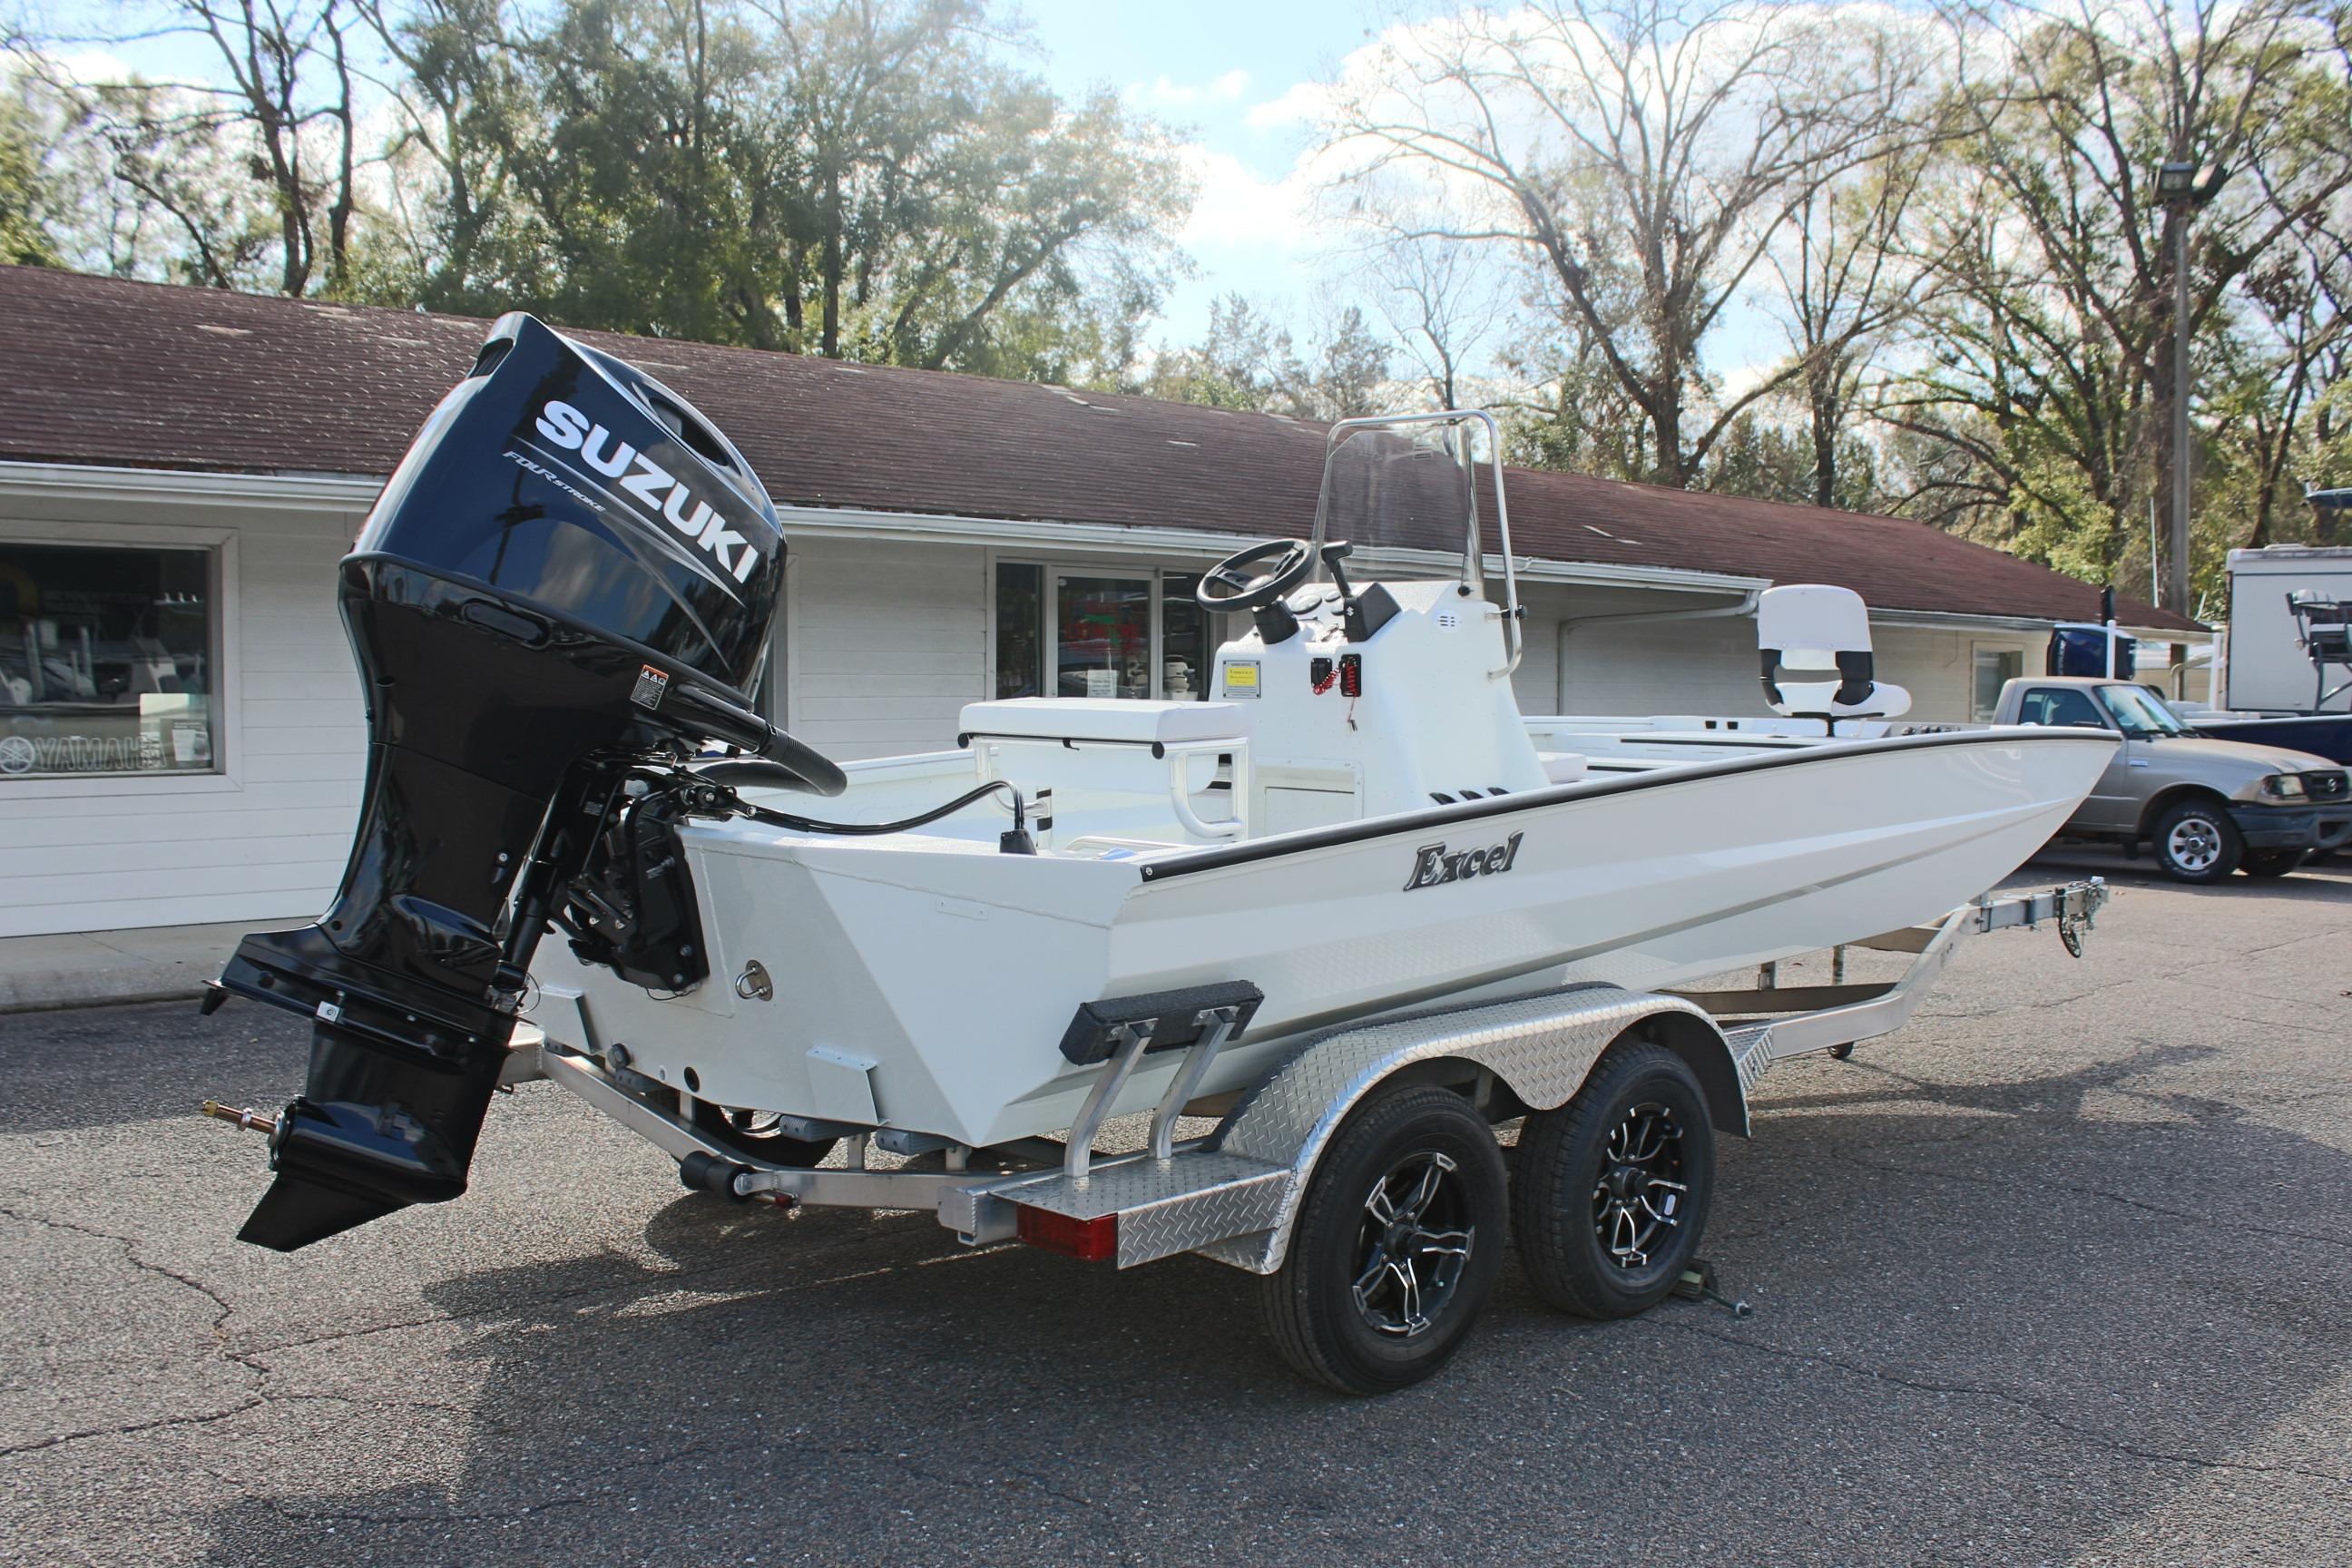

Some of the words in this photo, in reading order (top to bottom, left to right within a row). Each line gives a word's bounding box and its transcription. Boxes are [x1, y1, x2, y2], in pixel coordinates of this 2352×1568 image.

[535, 400, 759, 584] SUZUKI
[34, 736, 167, 770] YAMAHA
[1403, 829, 1524, 892] Excel
